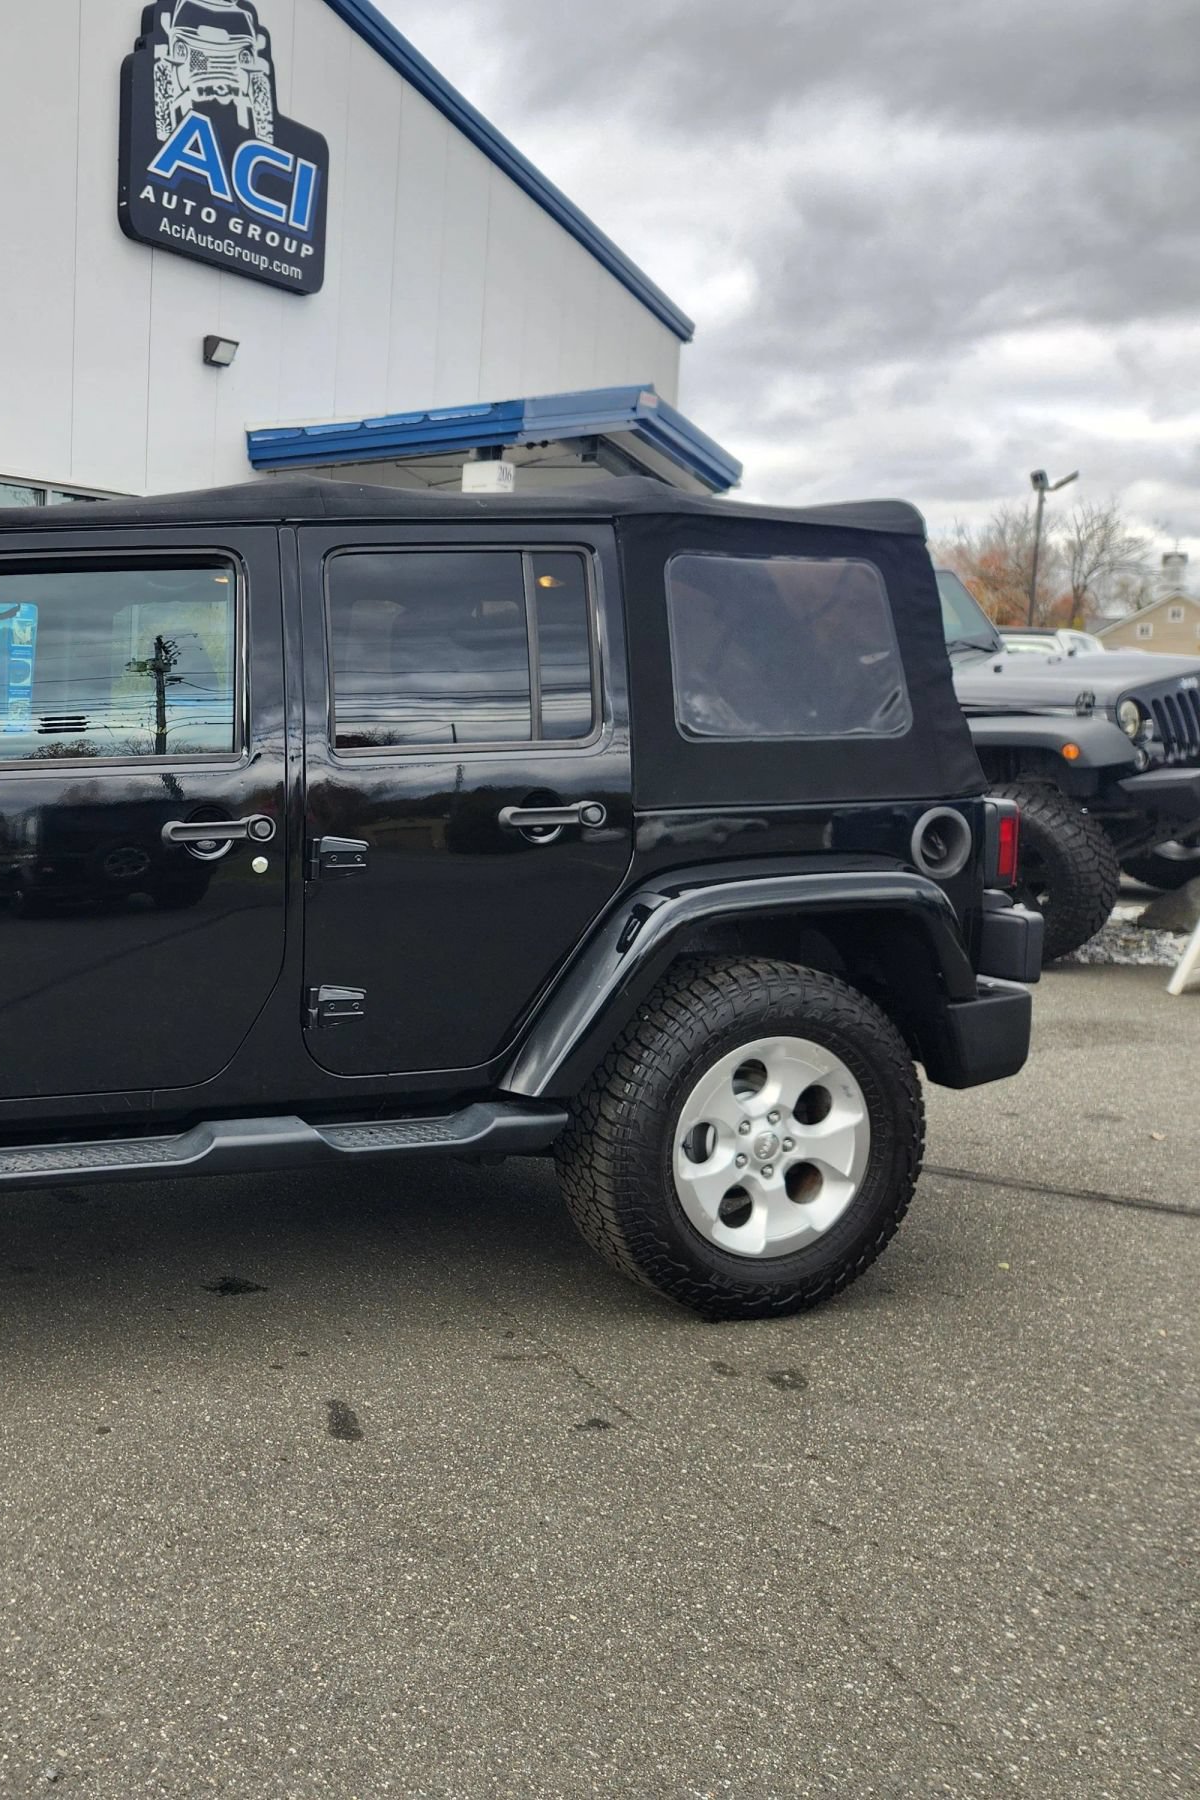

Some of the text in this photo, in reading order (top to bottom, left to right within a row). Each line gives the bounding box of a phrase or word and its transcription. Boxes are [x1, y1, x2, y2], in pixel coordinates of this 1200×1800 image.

[147, 109, 318, 233] ACI
[139, 185, 315, 258] AUTO GROUP
[158, 217, 303, 280] AciAutoGroup.com
